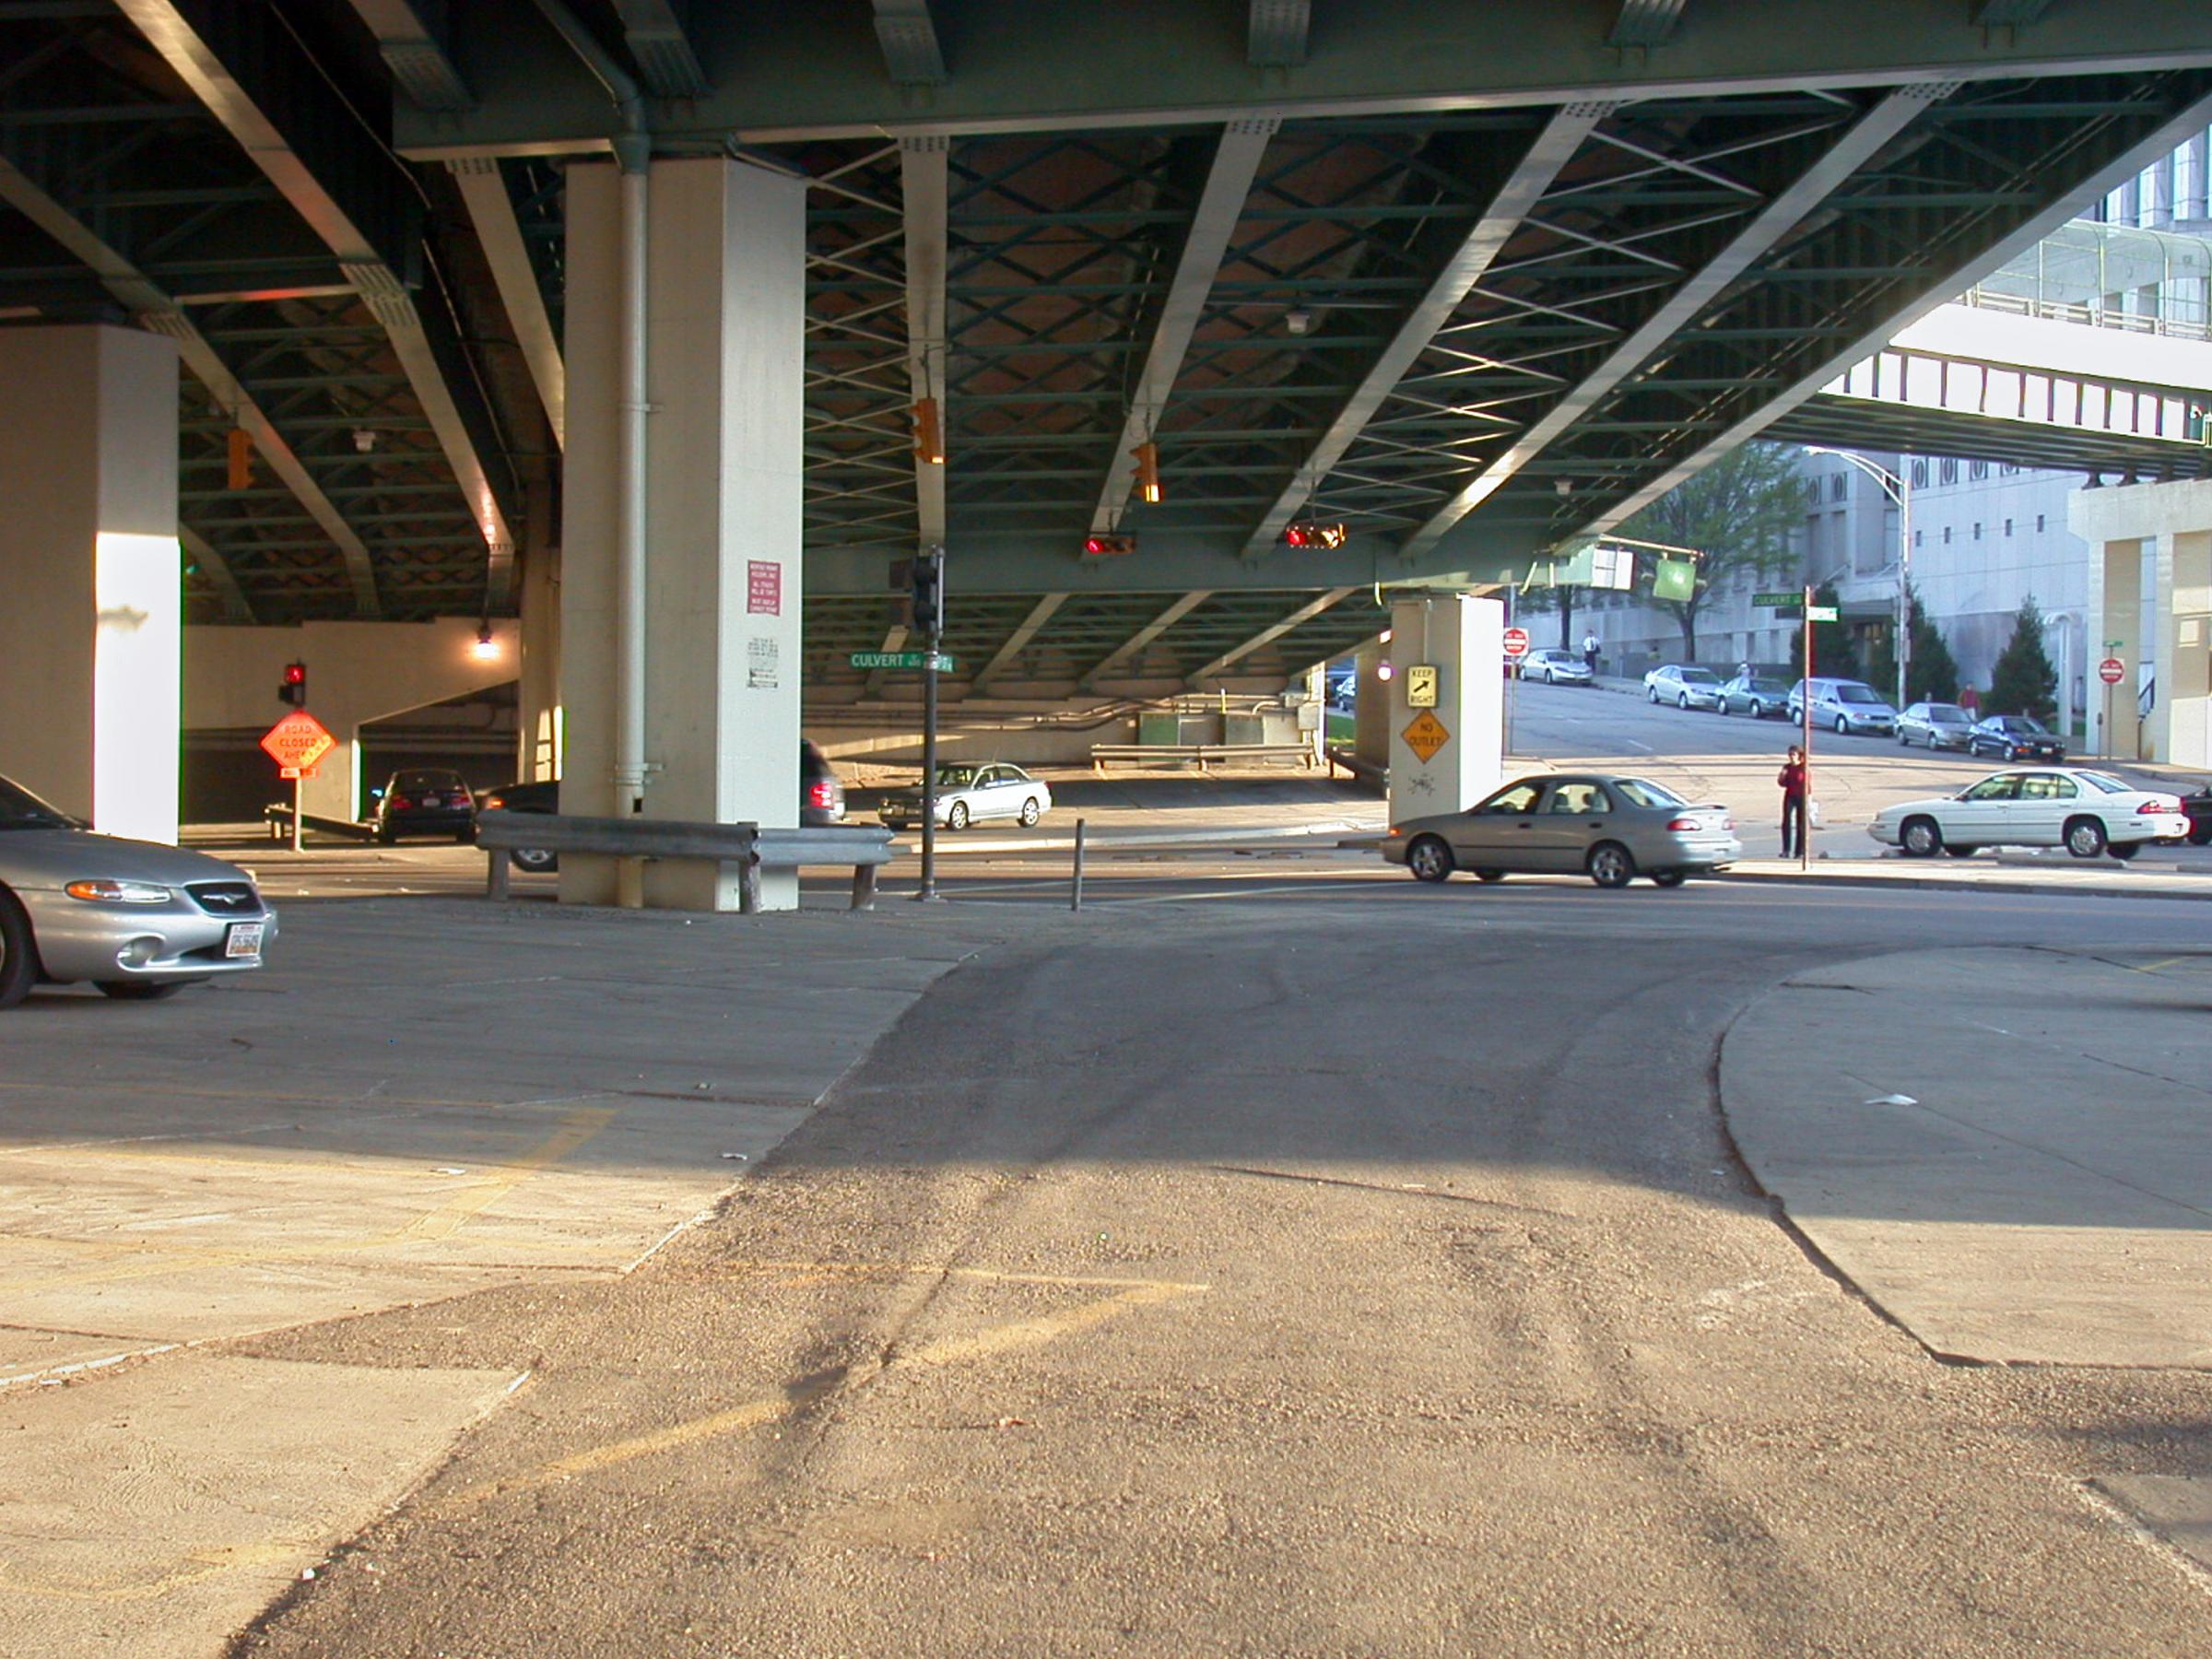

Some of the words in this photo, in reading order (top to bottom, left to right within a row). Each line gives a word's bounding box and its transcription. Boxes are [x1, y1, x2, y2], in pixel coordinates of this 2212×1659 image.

[852, 653, 904, 666] CULVERT
[1412, 669, 1432, 677] KEEP
[1410, 695, 1433, 704] RIGHT
[286, 725, 312, 735] ROAD
[1420, 724, 1433, 733] NO
[280, 738, 316, 747] CLOSED
[1410, 736, 1441, 746] OUTLET
